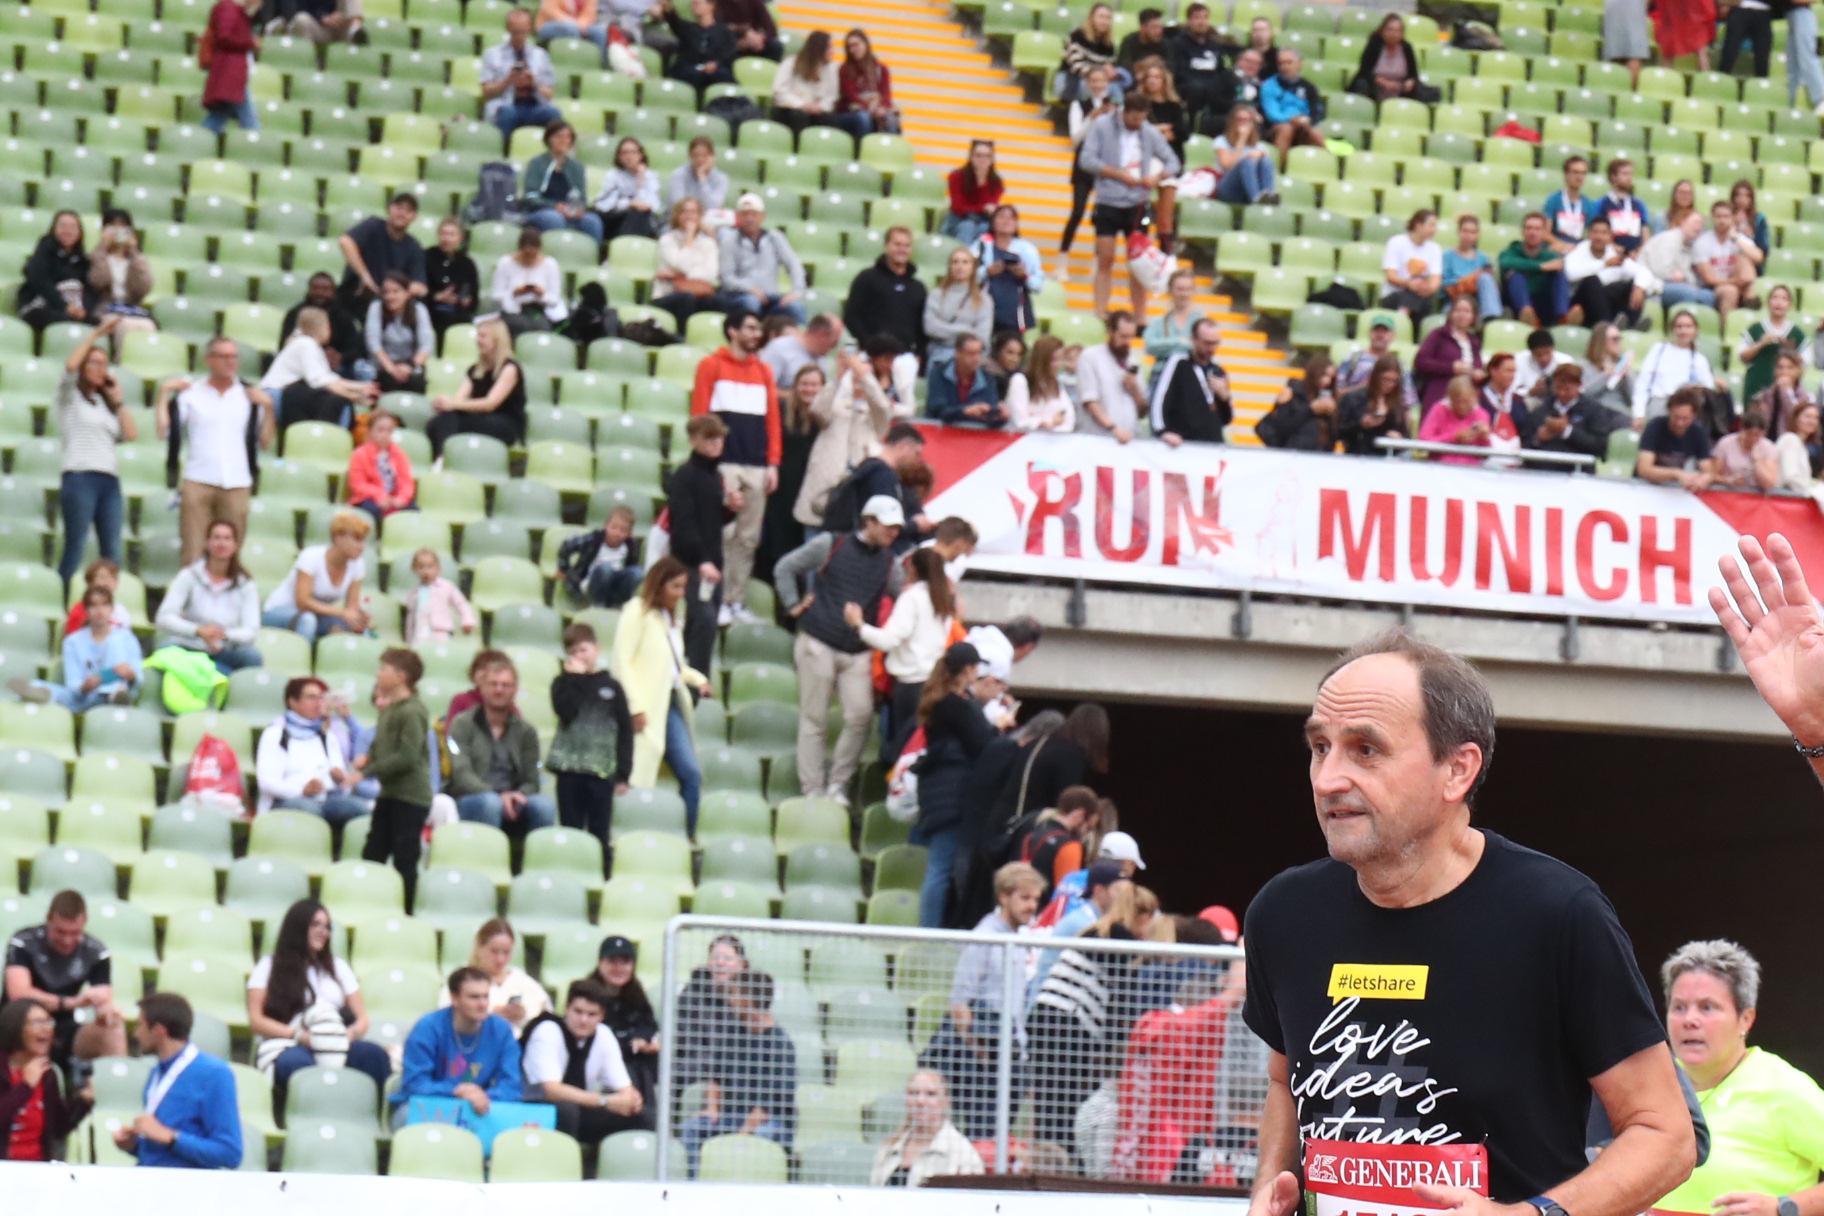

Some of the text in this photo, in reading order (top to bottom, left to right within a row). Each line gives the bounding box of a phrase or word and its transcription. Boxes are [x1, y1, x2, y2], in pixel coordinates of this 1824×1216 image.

[1024, 460, 1694, 606] RUN MUNICH
[1338, 974, 1416, 992] #letshare
[1309, 996, 1431, 1060] love
[1290, 1050, 1458, 1115] ideas
[1339, 1157, 1482, 1188] GENERALI
